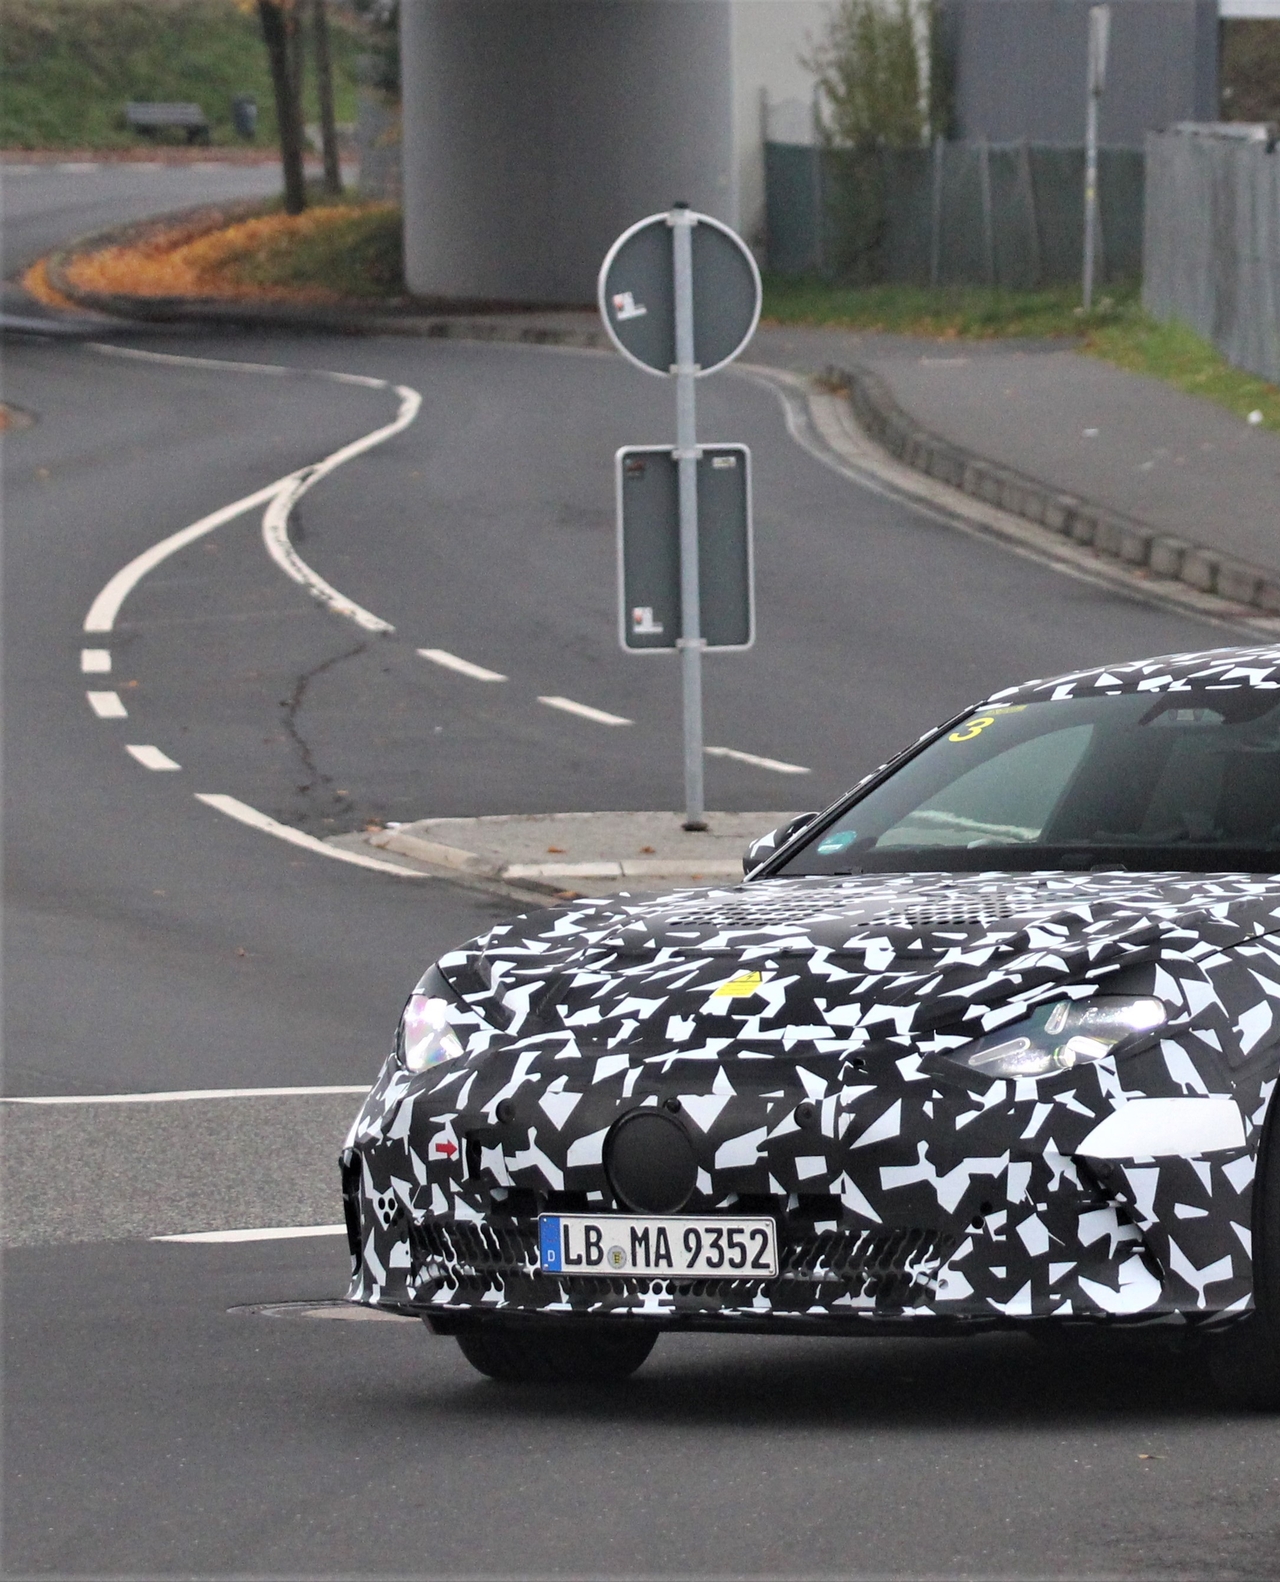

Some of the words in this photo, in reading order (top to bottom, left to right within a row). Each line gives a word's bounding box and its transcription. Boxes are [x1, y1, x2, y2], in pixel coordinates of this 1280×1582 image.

[949, 717, 995, 742] 3
[547, 1250, 555, 1262] D
[563, 1224, 604, 1266] LB
[630, 1226, 673, 1267] MA
[683, 1227, 771, 1269] 9352
